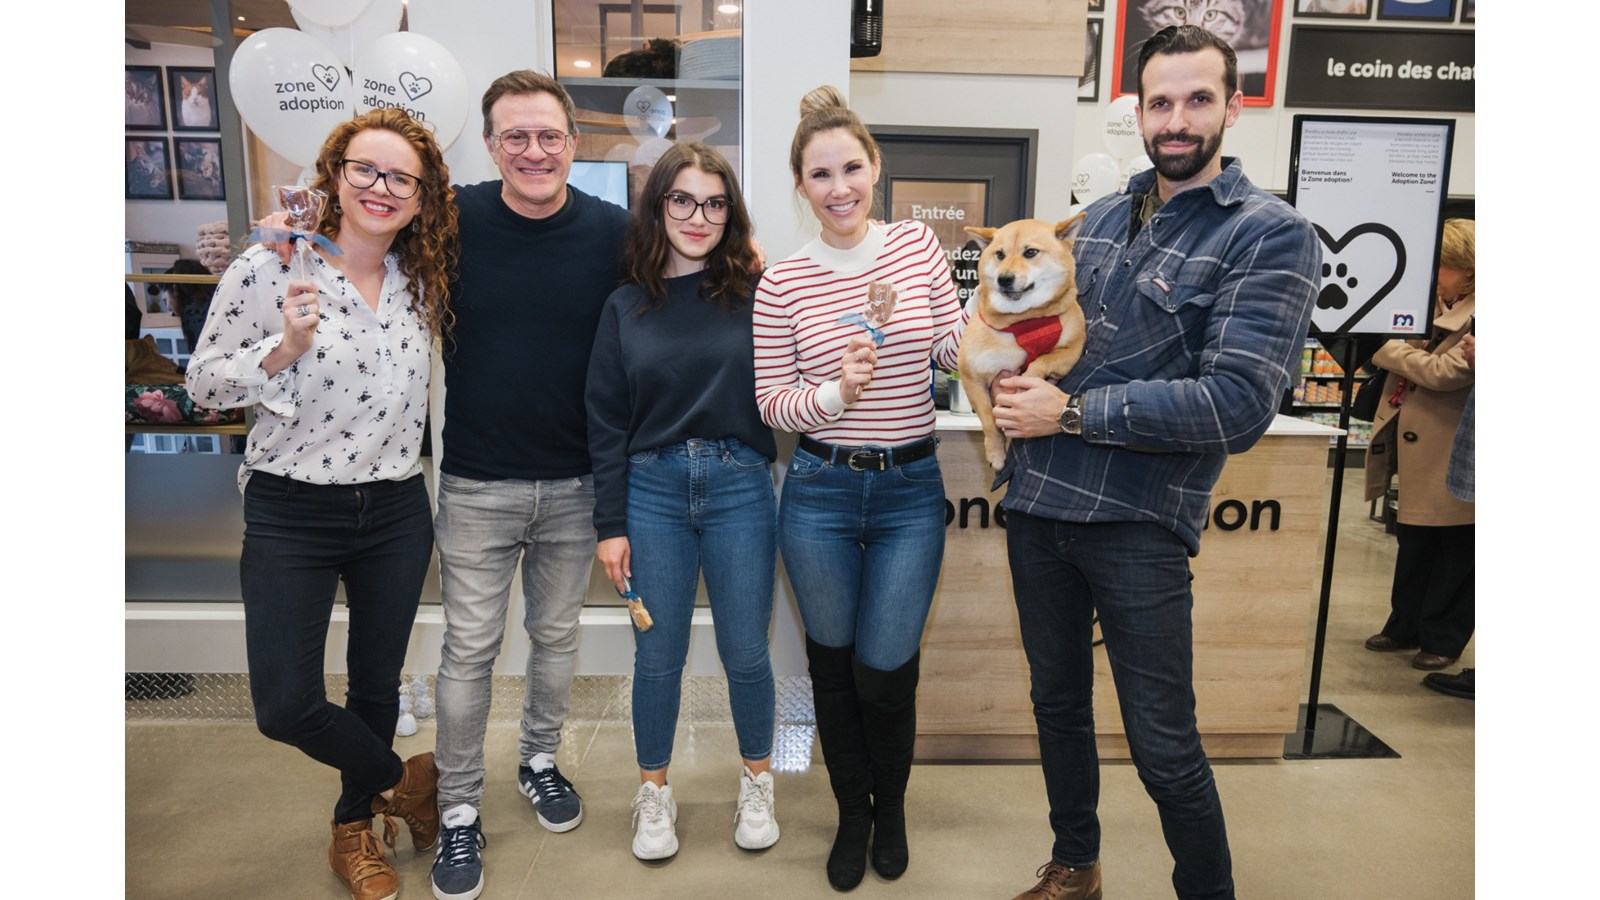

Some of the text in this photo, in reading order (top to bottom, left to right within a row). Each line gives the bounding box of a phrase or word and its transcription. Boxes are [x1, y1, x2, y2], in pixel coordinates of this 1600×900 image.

[1327, 57, 1475, 80] le coin des cha
[275, 79, 316, 94] zone
[363, 78, 397, 96] zone
[279, 96, 345, 113] adoption
[911, 204, 966, 220] Entrée
